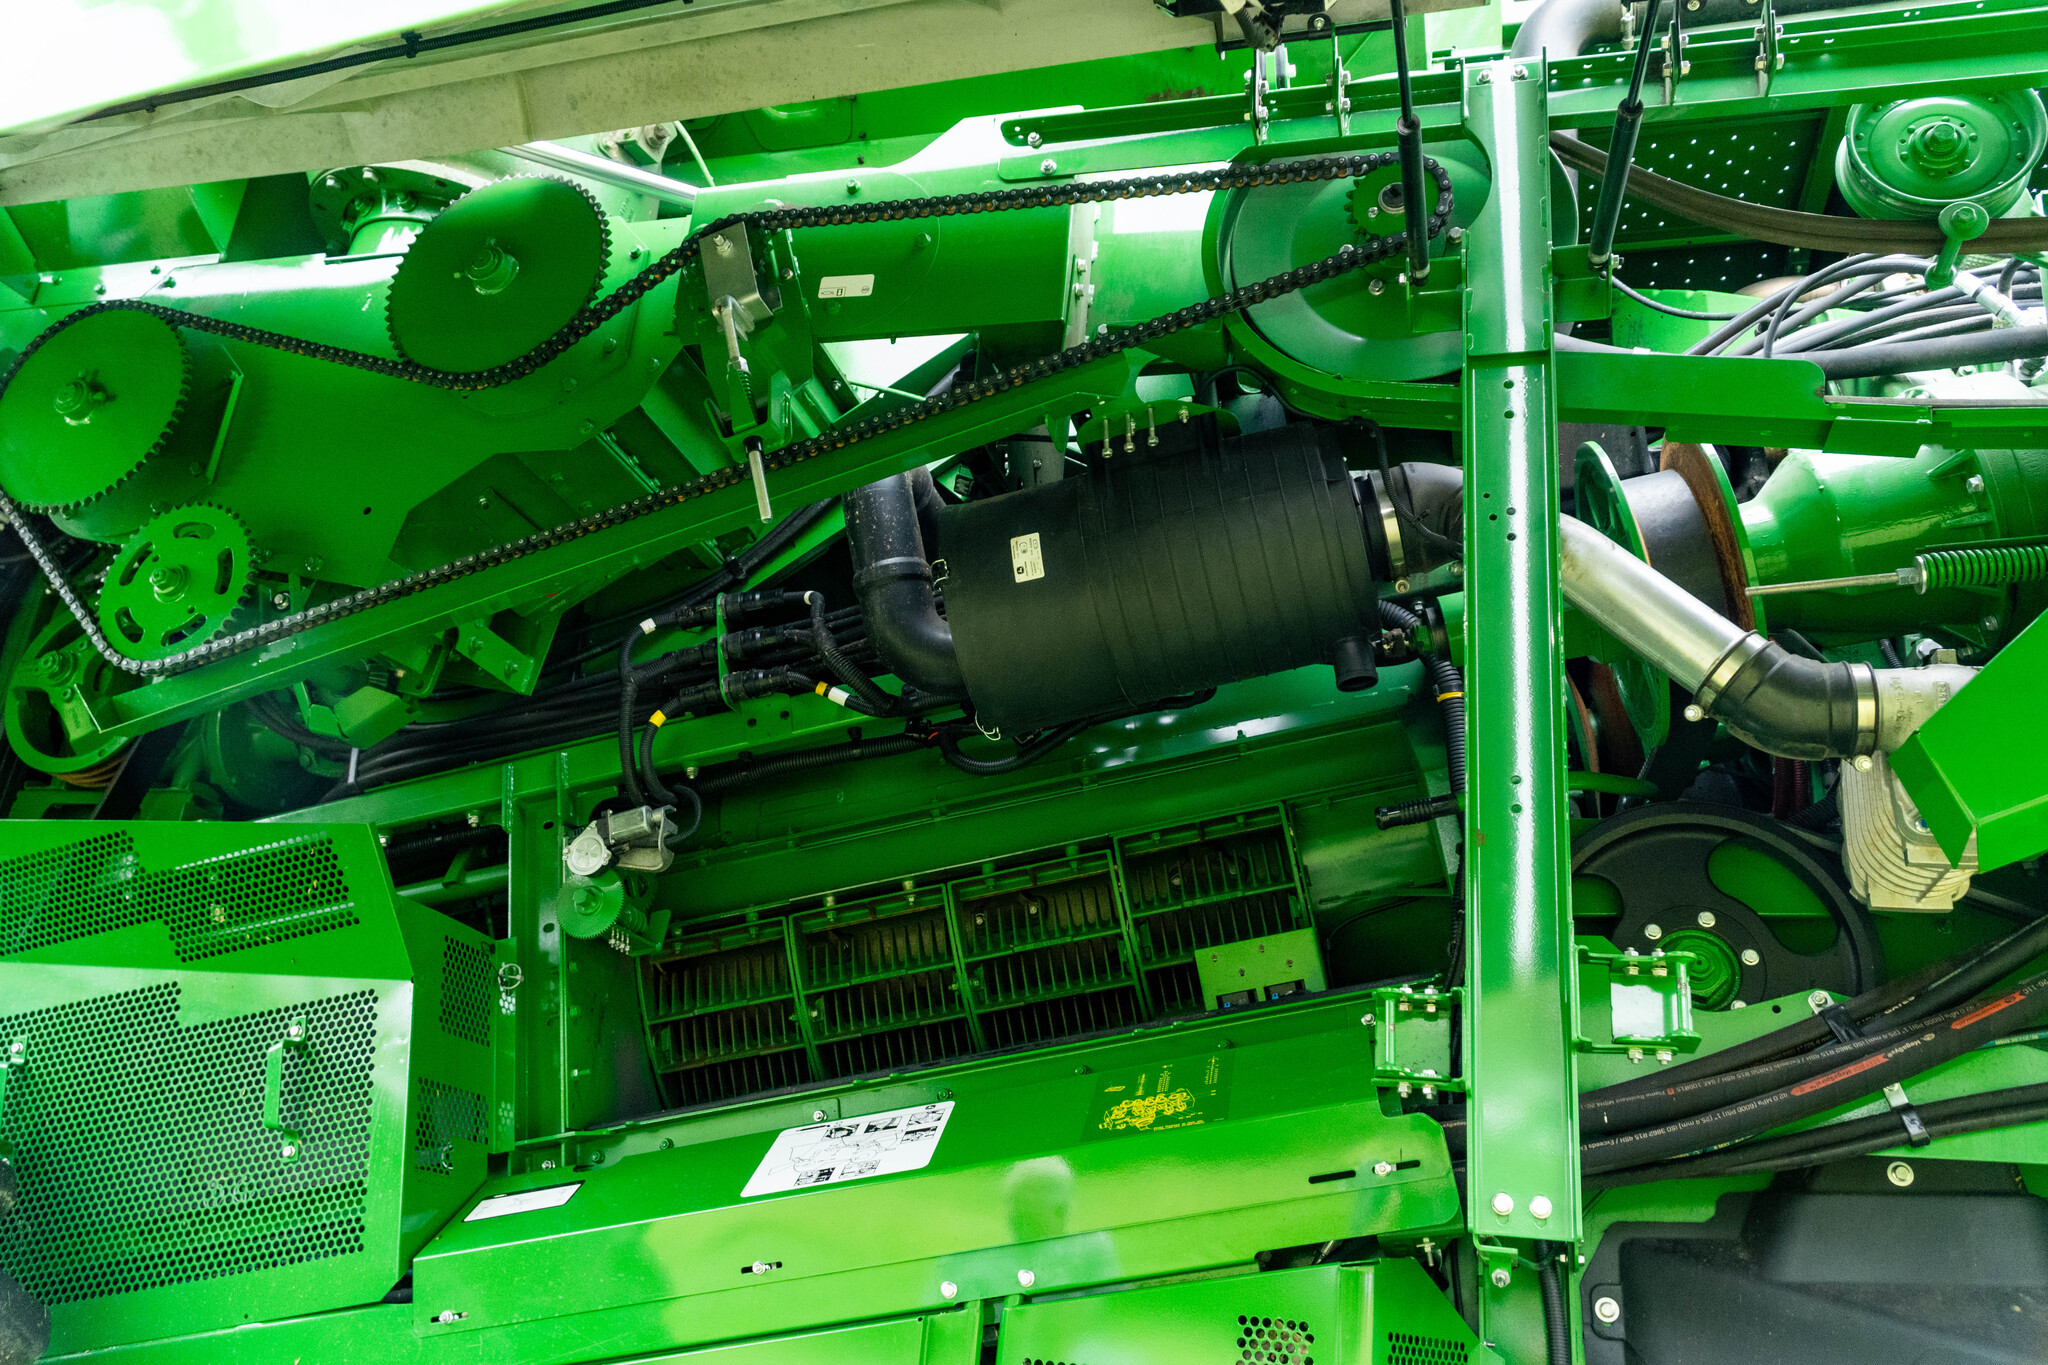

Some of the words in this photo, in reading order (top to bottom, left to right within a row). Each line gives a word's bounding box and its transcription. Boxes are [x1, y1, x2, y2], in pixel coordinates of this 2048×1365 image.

[1757, 1096, 1772, 1106] MPa
[1666, 1124, 1677, 1132] ISO
[1677, 1119, 1694, 1129] mm)
[1634, 1132, 1647, 1140] R15
[1588, 1139, 1614, 1149] Exceeds
